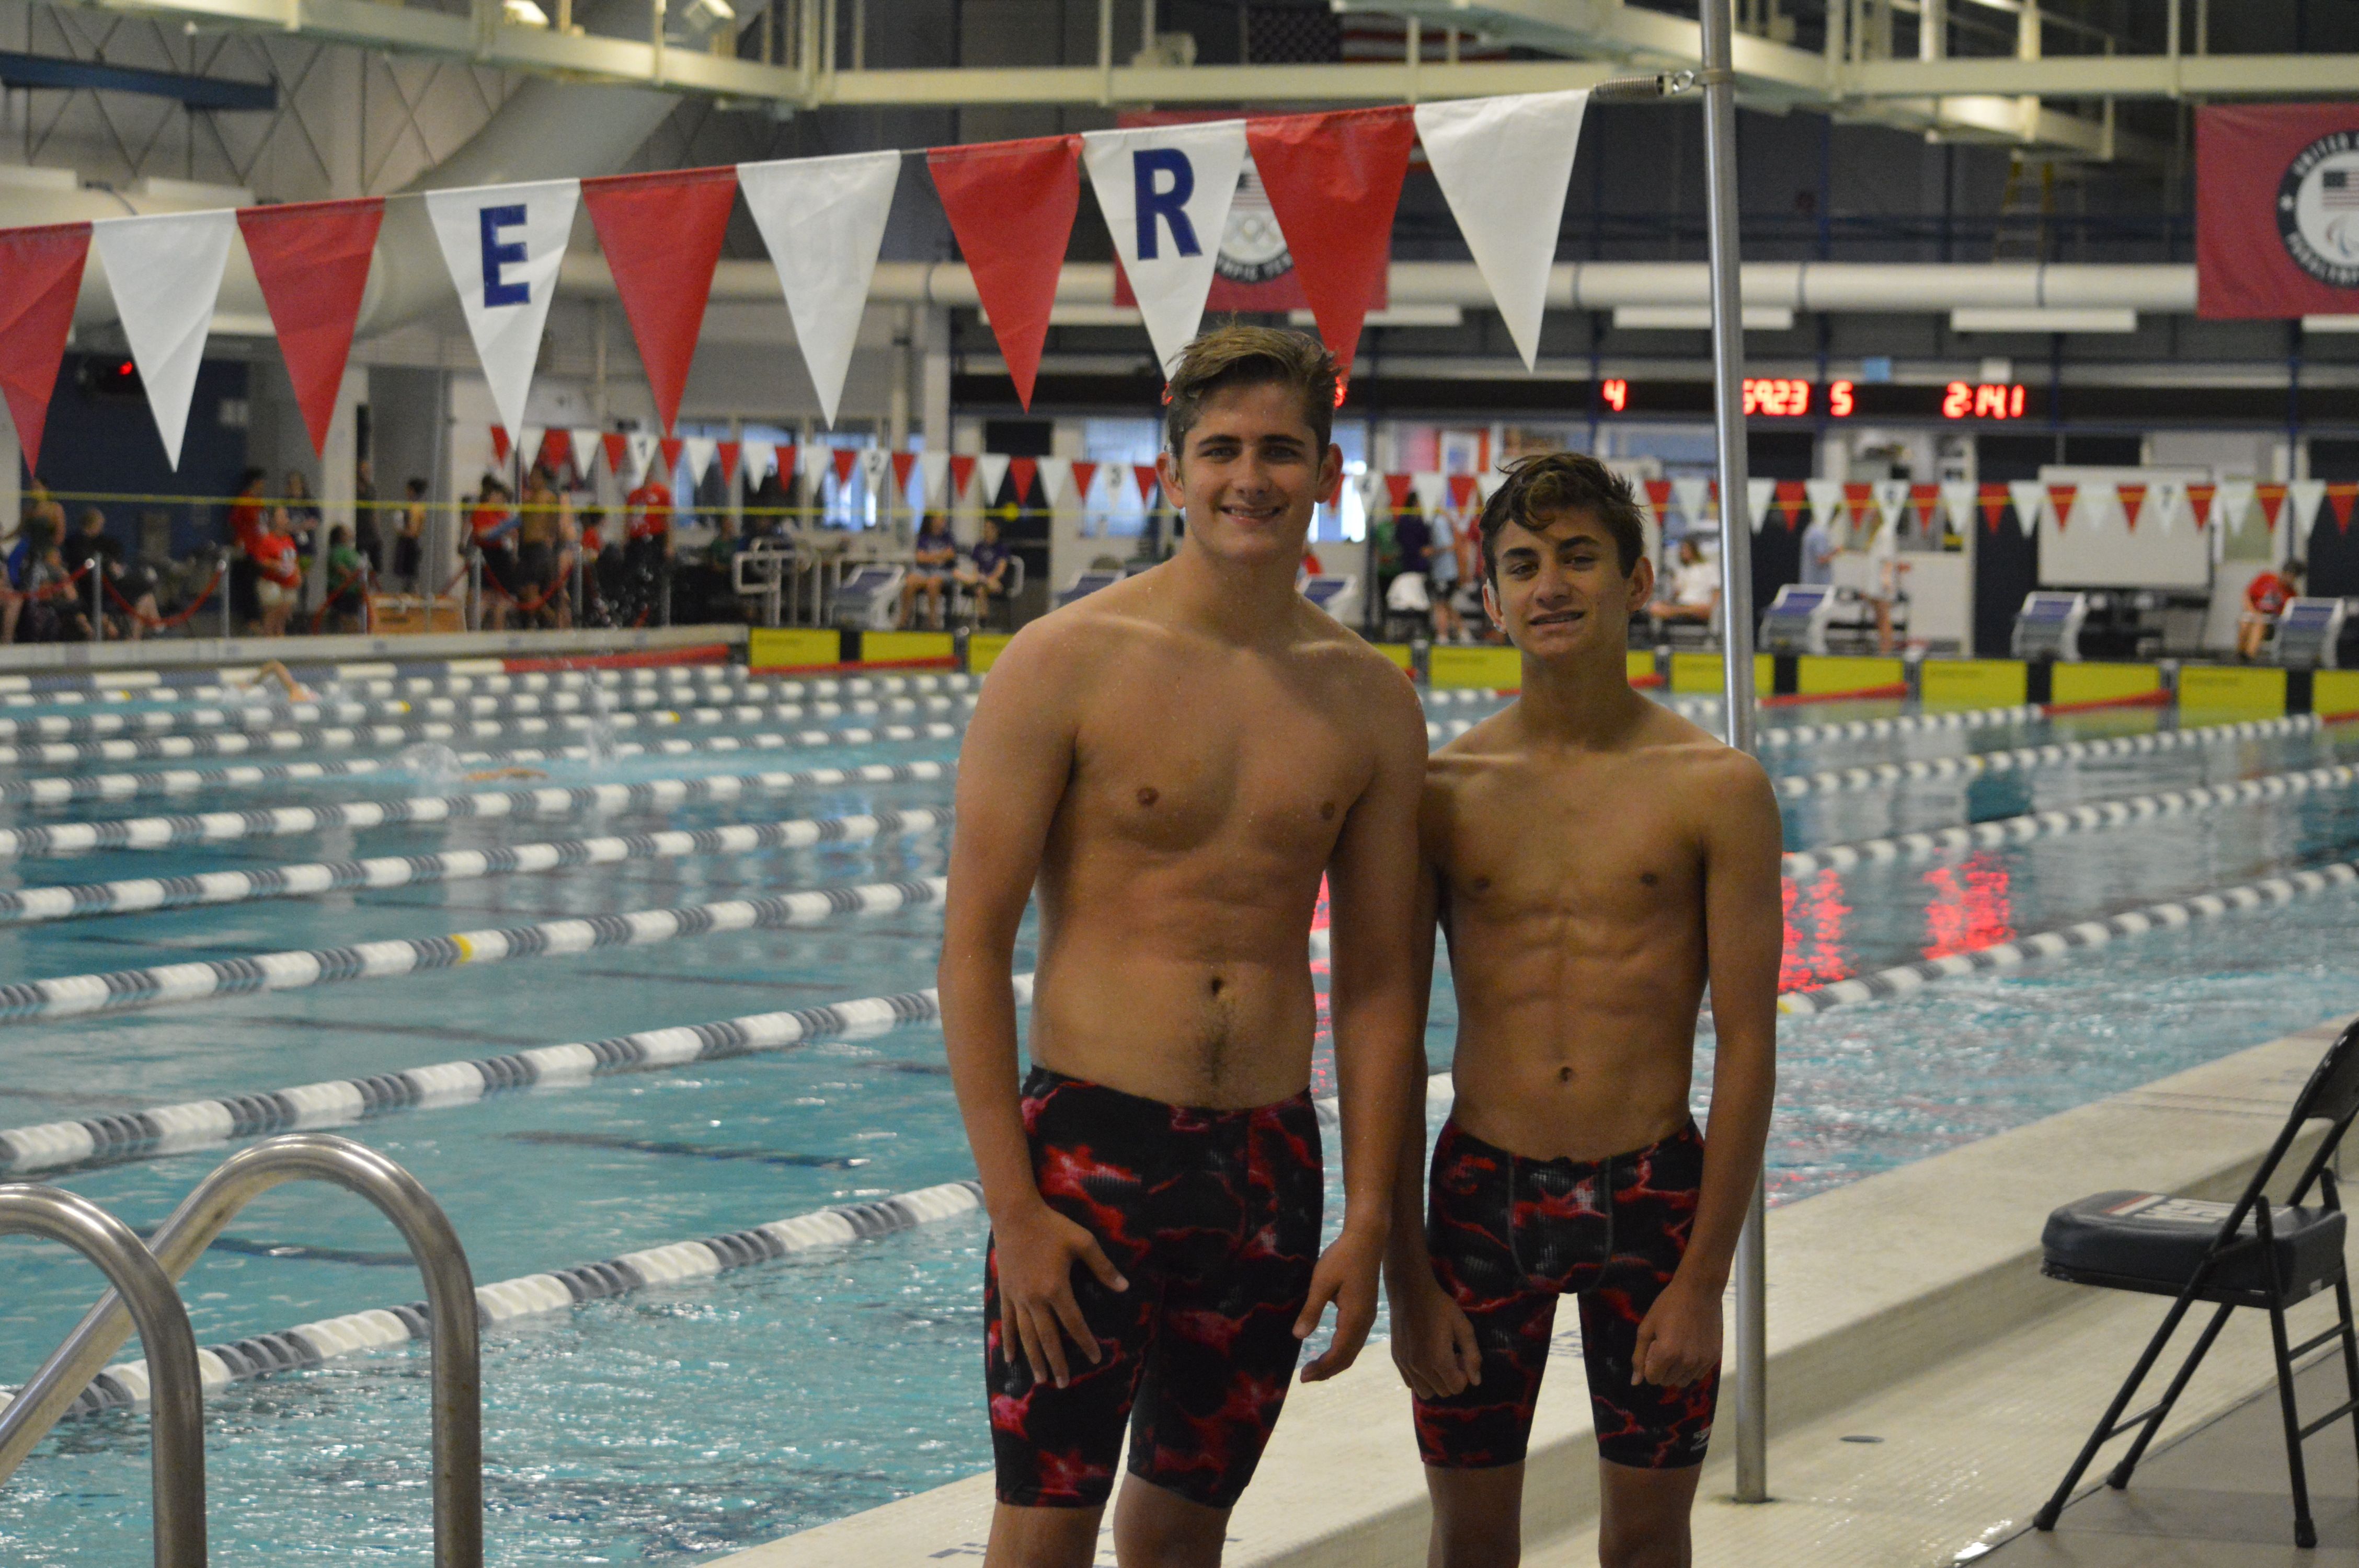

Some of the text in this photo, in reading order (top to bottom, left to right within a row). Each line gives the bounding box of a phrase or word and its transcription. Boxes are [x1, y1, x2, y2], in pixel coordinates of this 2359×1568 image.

[479, 204, 530, 308] E
[1133, 148, 1203, 260] R
[1602, 378, 1627, 412] 4
[1829, 379, 1854, 417] 5
